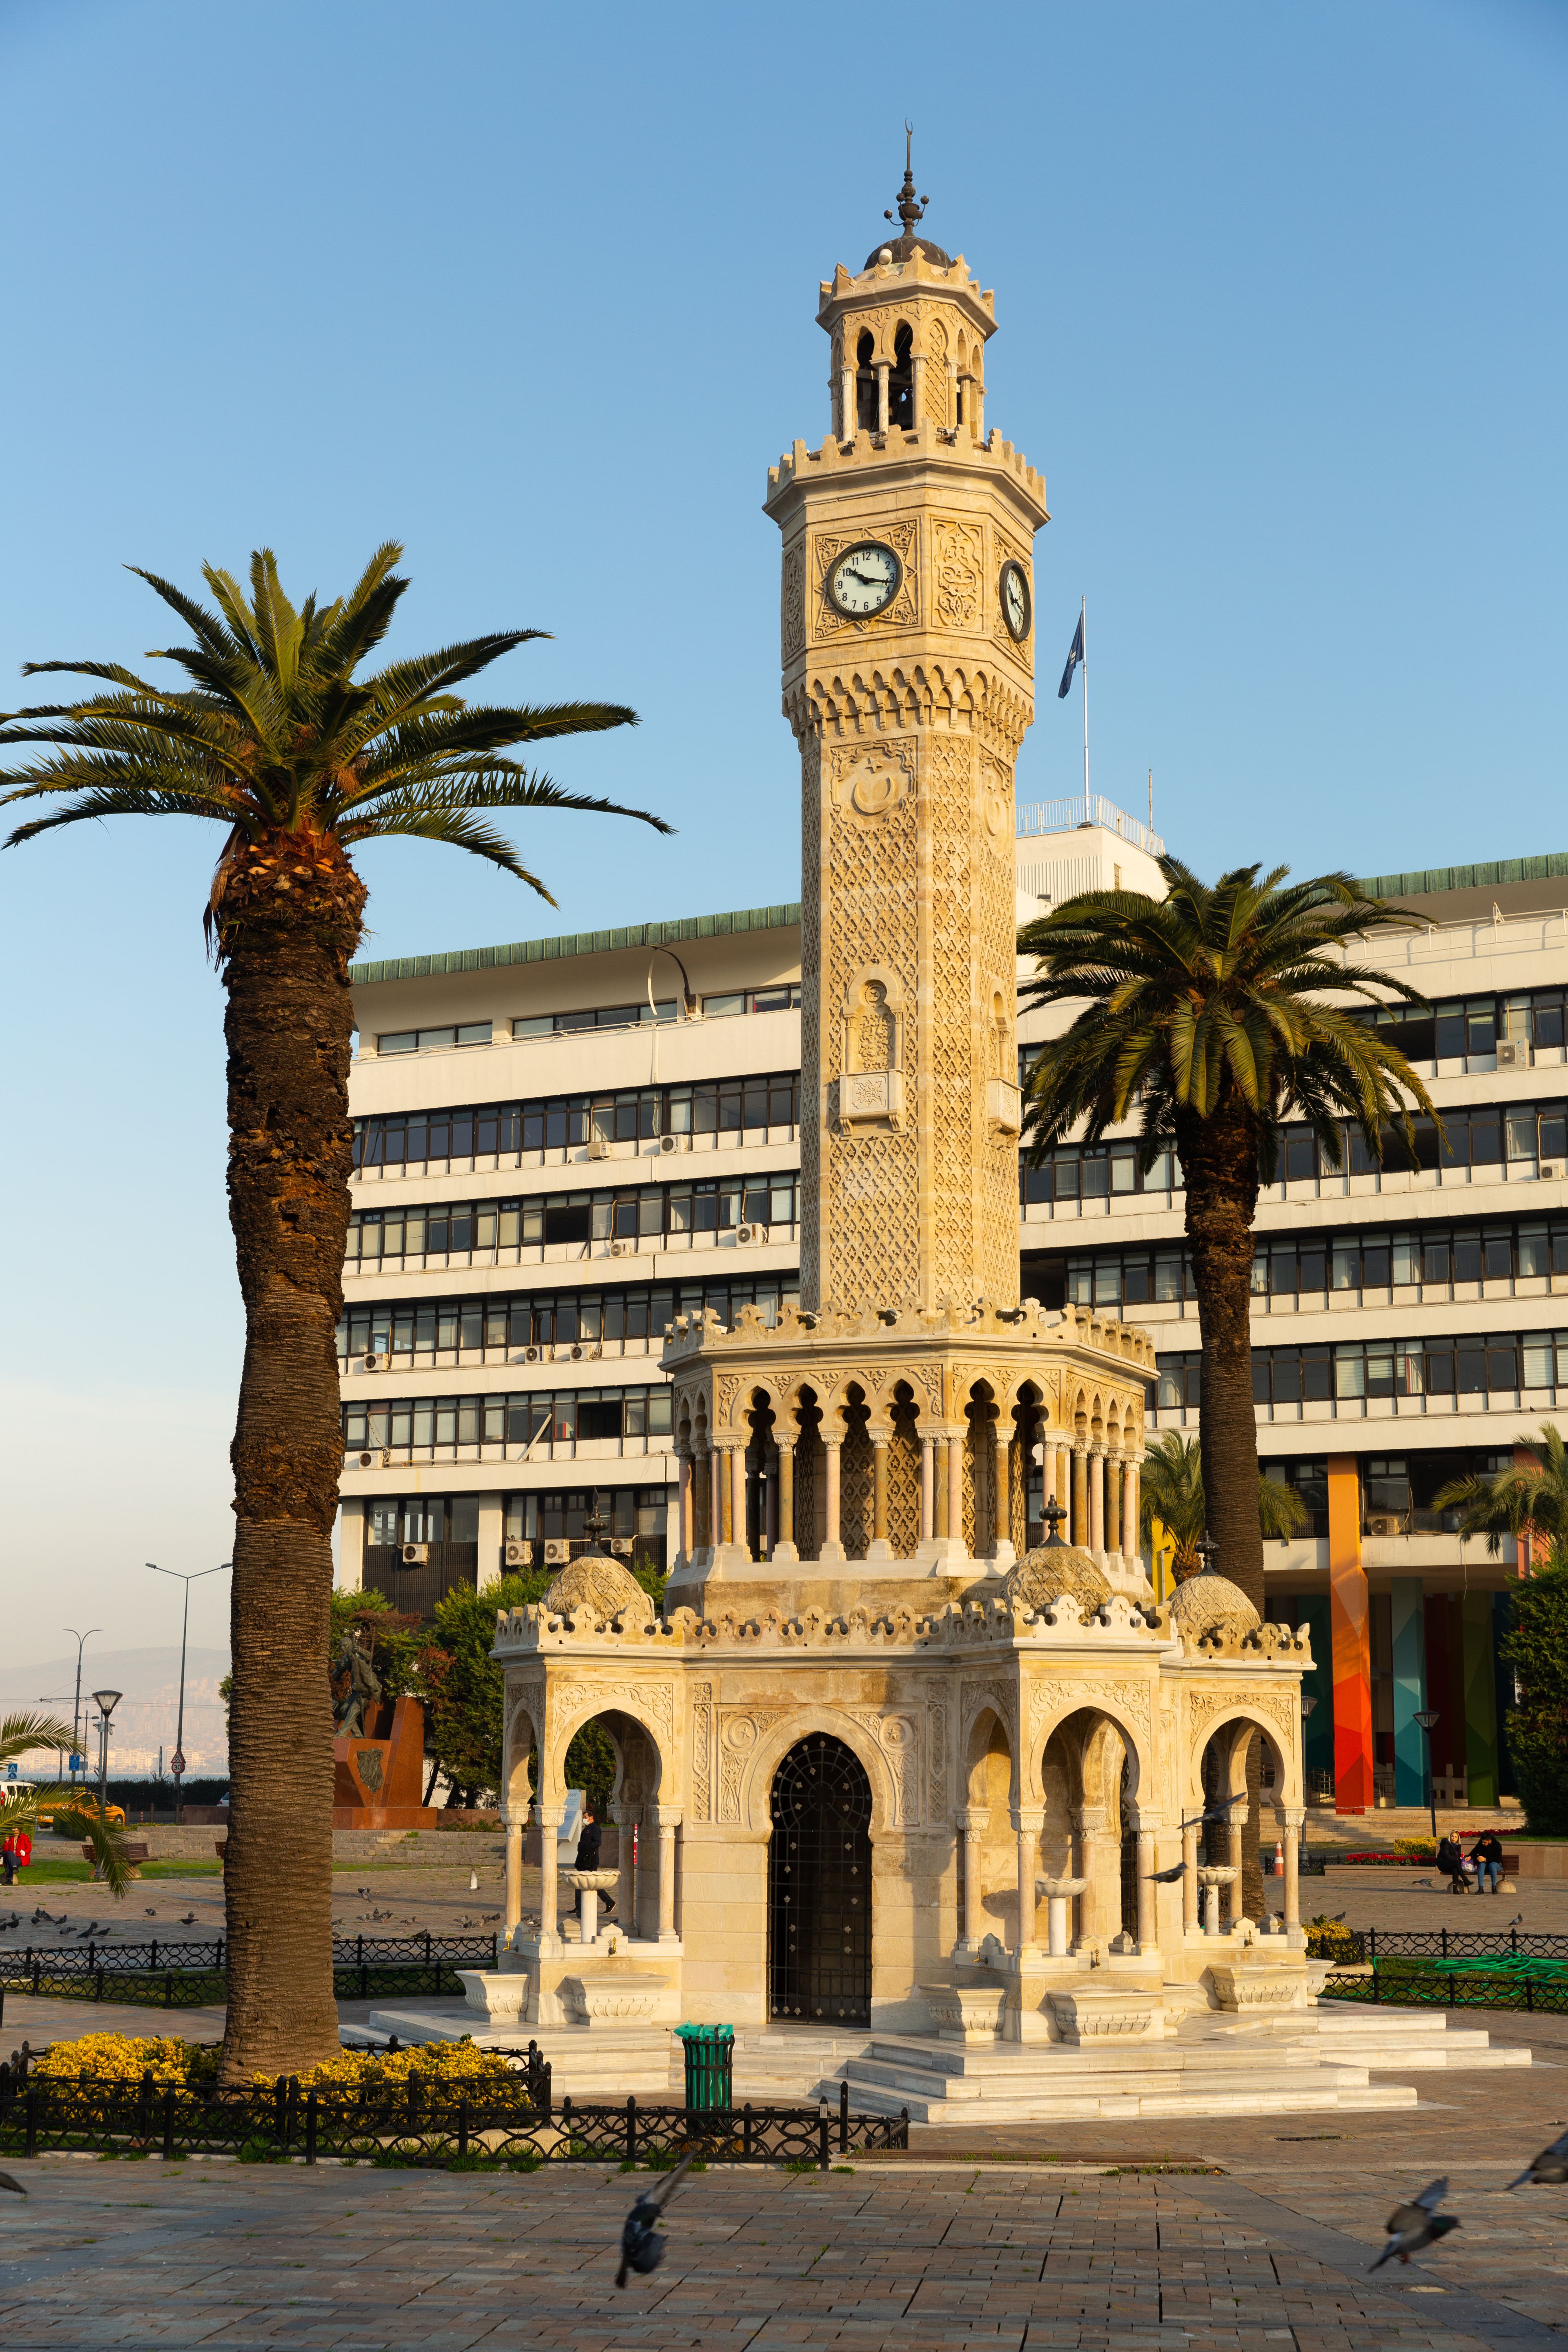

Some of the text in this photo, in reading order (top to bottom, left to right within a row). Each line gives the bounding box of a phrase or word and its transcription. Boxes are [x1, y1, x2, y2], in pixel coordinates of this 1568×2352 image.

[862, 552, 871, 561] 12
[876, 553, 880, 562] 1
[851, 557, 859, 566] 11
[885, 561, 890, 570] 2
[842, 568, 851, 577] 10
[889, 573, 894, 581] 3
[1010, 571, 1014, 581] 12
[838, 581, 843, 589] 9
[885, 586, 890, 595] 4
[842, 593, 847, 601] 8
[877, 596, 882, 605] 5
[852, 600, 857, 608] 7
[864, 601, 869, 610] 6
